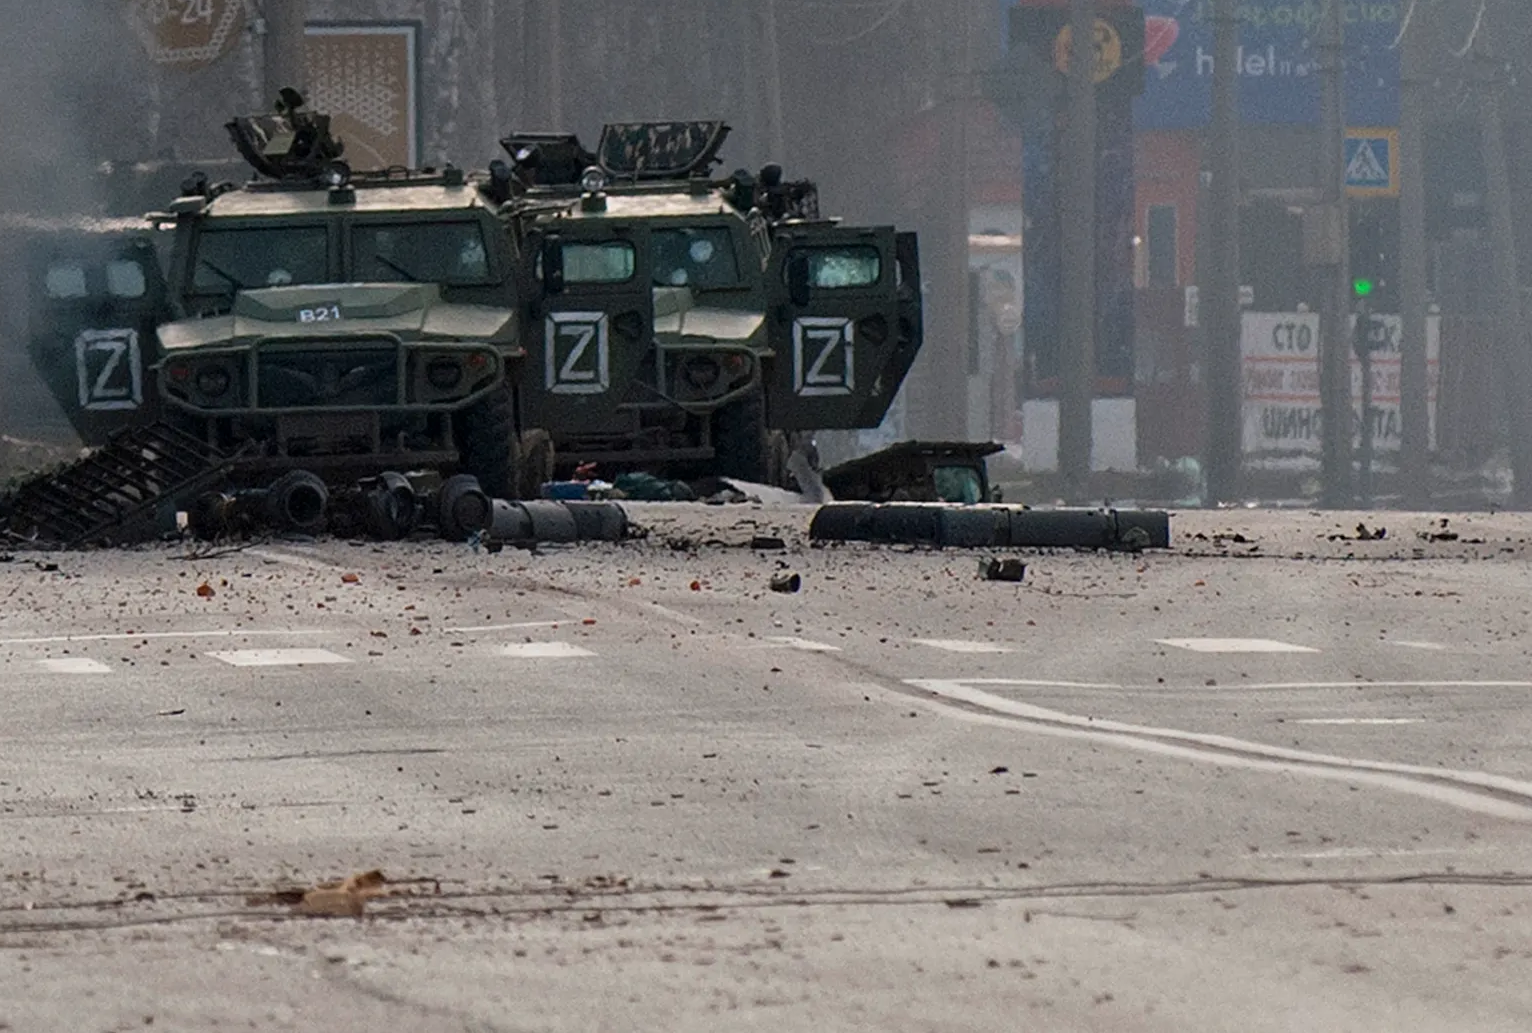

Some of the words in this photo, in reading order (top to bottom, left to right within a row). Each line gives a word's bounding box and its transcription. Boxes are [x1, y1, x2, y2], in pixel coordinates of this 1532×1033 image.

[299, 305, 340, 323] B21
[1272, 323, 1312, 352] СТО
[87, 339, 128, 398] Z
[558, 323, 596, 381] Z
[805, 329, 840, 385] Z
